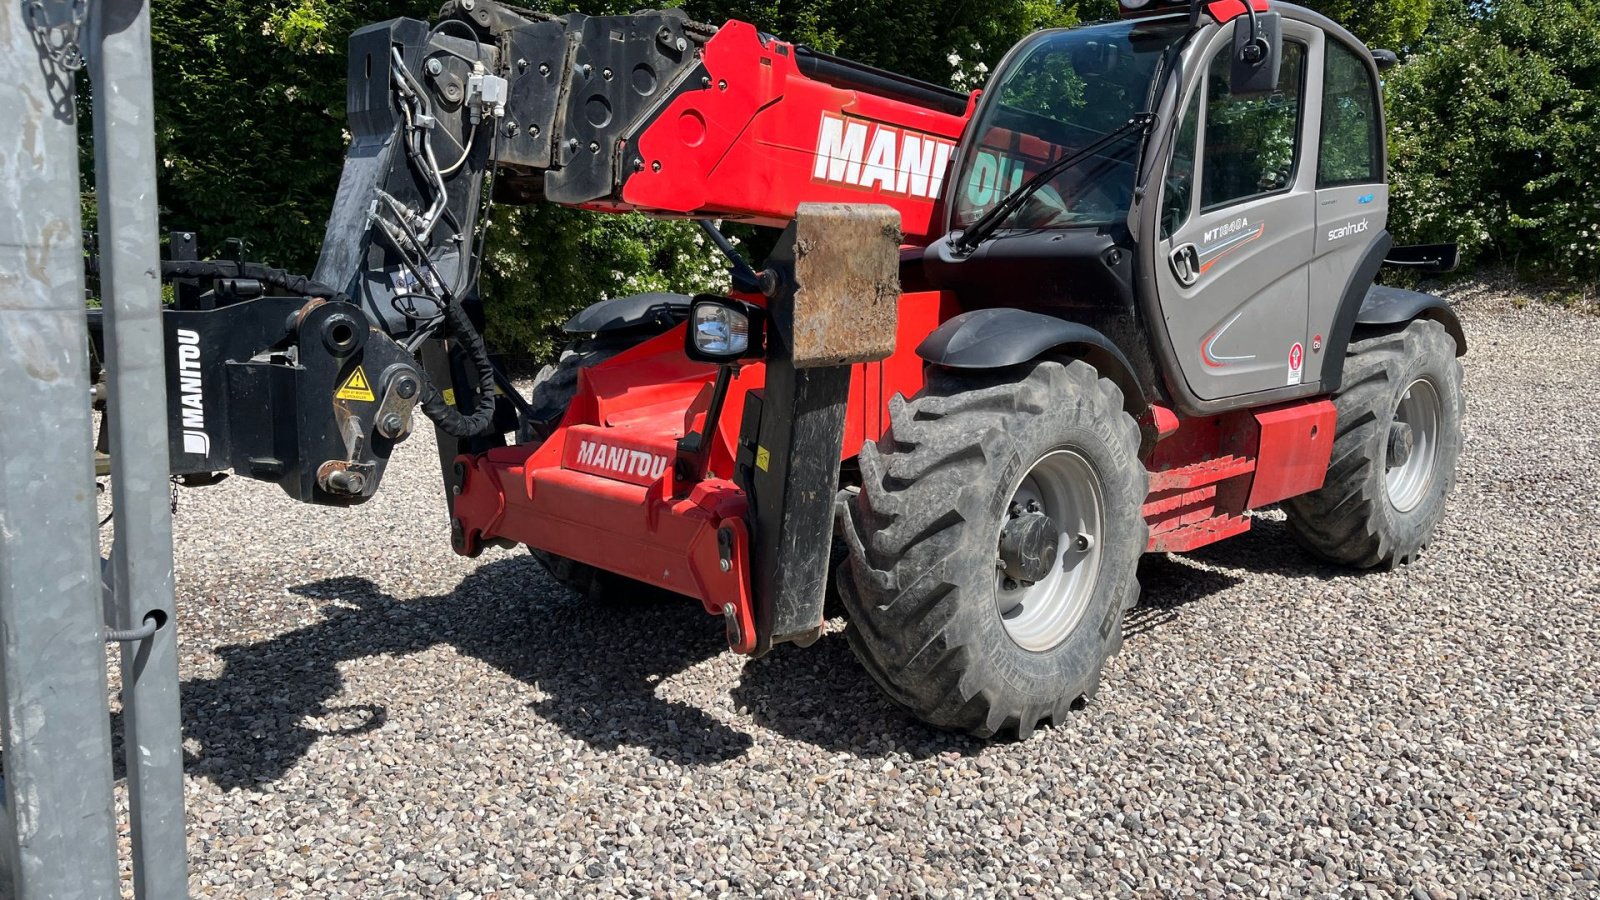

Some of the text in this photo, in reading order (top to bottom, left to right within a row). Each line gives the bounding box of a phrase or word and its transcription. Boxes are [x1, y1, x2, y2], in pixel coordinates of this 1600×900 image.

[1328, 217, 1368, 241] scantruck
[177, 328, 204, 429] MANITOU
[577, 440, 668, 480] MANITOU
